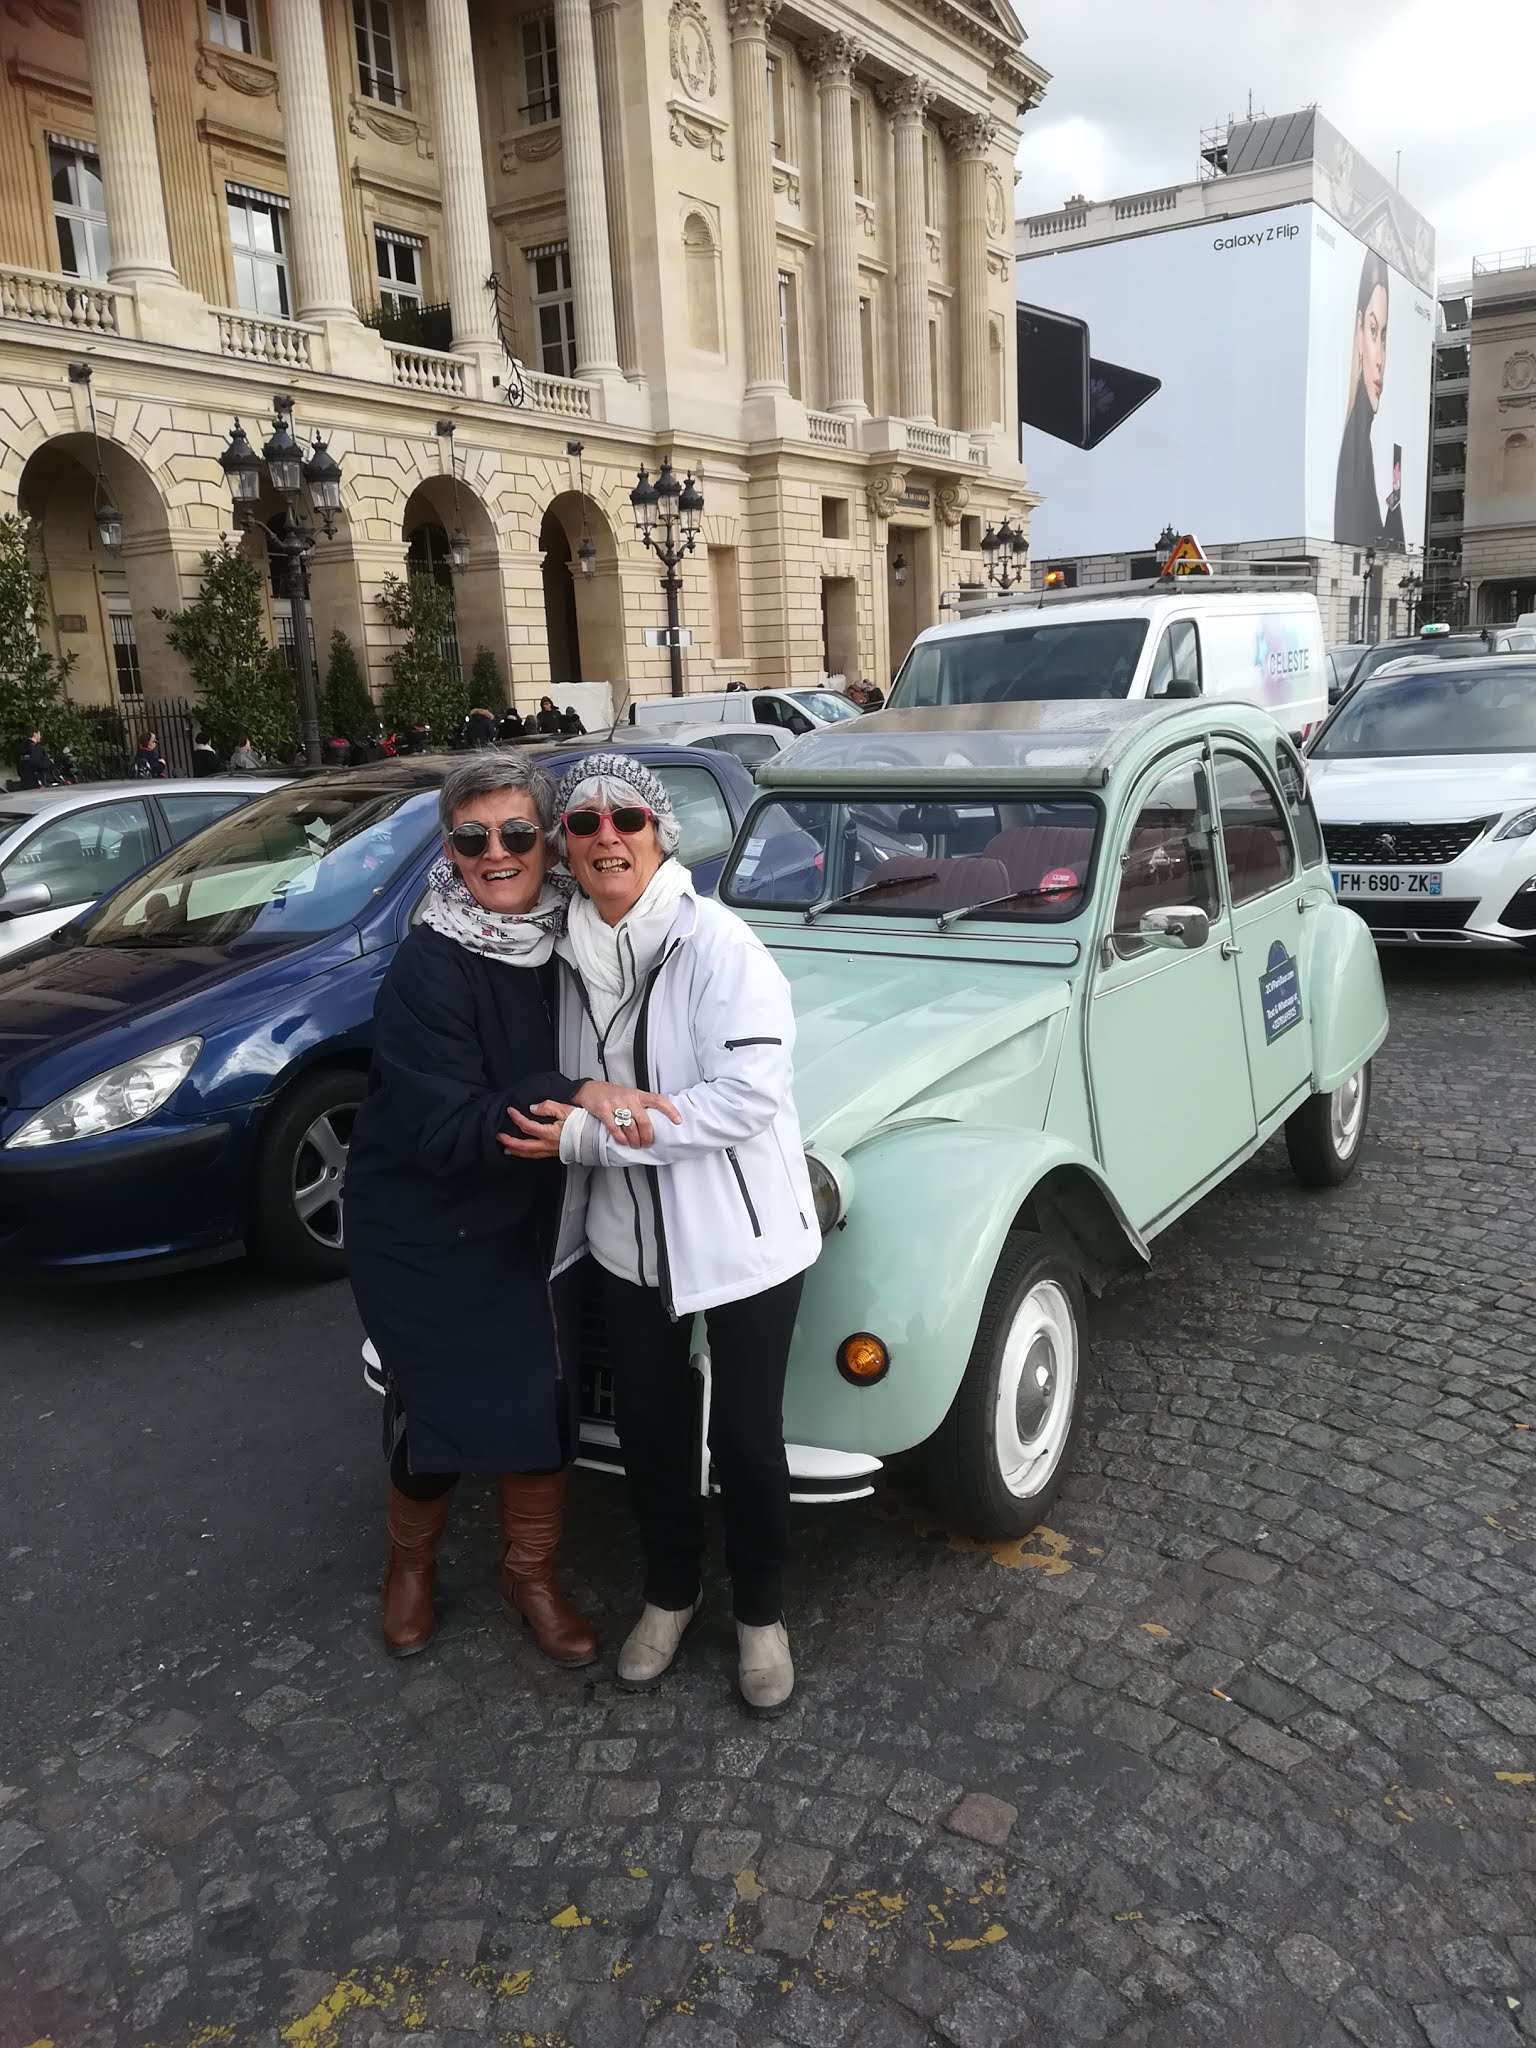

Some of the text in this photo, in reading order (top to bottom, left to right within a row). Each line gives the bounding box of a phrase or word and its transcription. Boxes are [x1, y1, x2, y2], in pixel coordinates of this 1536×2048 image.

[1213, 232, 1264, 251] Galaxy
[1266, 228, 1274, 241] Z
[1276, 223, 1299, 240] Flip
[1270, 648, 1309, 676] CELESTE
[1340, 874, 1440, 893] FM-690-ZK 75
